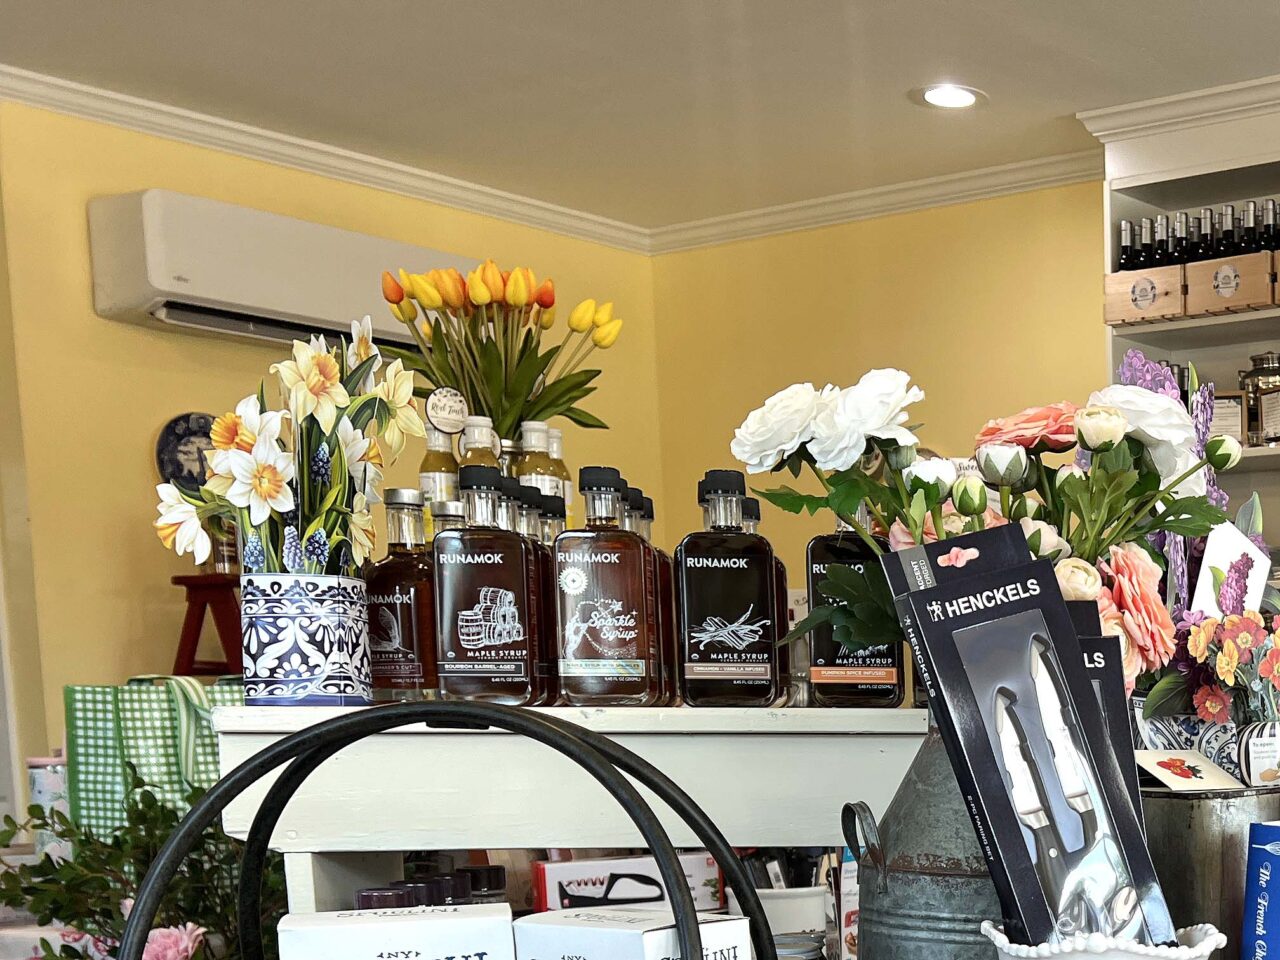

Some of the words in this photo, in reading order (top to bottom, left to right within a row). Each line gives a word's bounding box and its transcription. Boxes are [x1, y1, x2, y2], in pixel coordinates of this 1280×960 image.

[439, 553, 504, 564] RUNAMOK
[557, 553, 621, 564] RUNAMOK
[686, 557, 749, 569] RUNAMOK
[946, 578, 1041, 618] HENCKELS
[588, 611, 636, 629] Sparkle
[600, 627, 637, 641] Syrup
[836, 657, 863, 665] MAPLE
[866, 657, 892, 665] SYRUP
[908, 628, 936, 699] HENCKELS
[1257, 861, 1272, 888] The
[1255, 890, 1271, 936] French
